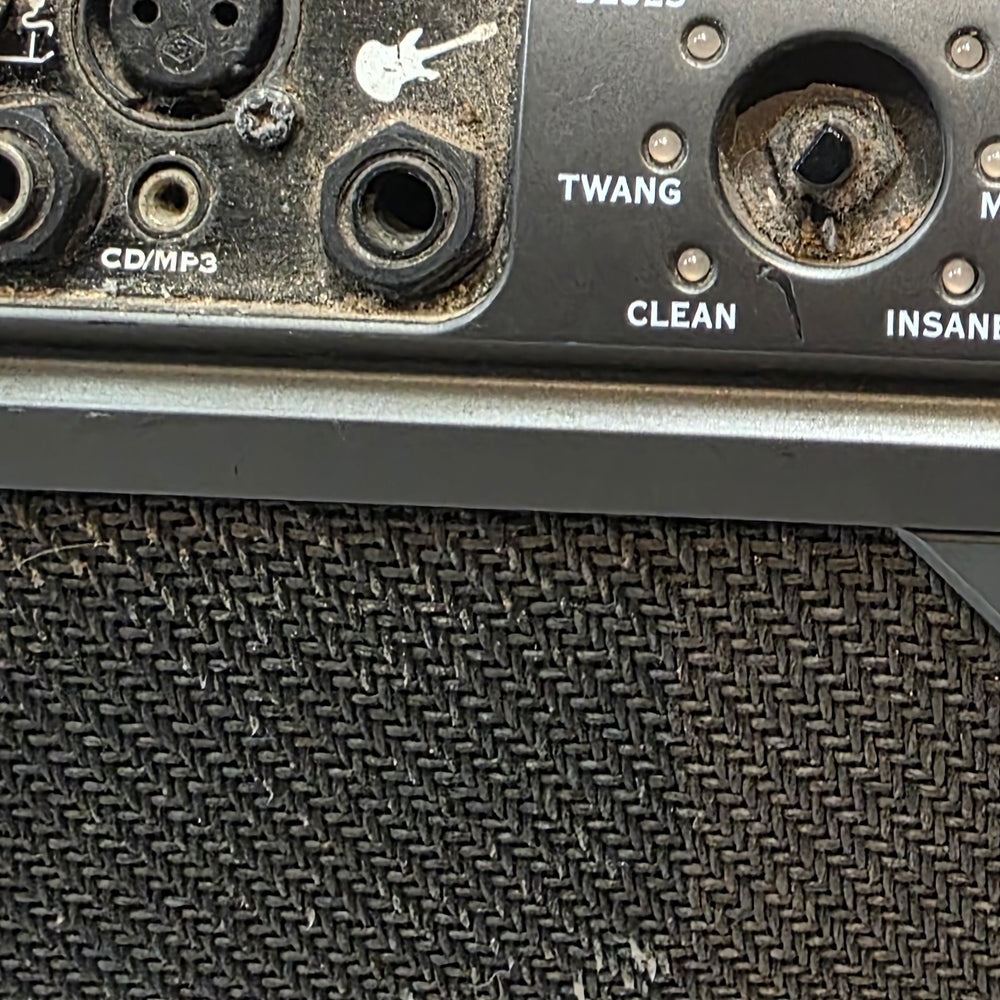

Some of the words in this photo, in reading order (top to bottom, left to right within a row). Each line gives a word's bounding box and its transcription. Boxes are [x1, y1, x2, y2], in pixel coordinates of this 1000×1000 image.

[557, 172, 683, 206] TWANG
[100, 246, 220, 275] CD/MP3
[625, 300, 737, 331] CLEAN
